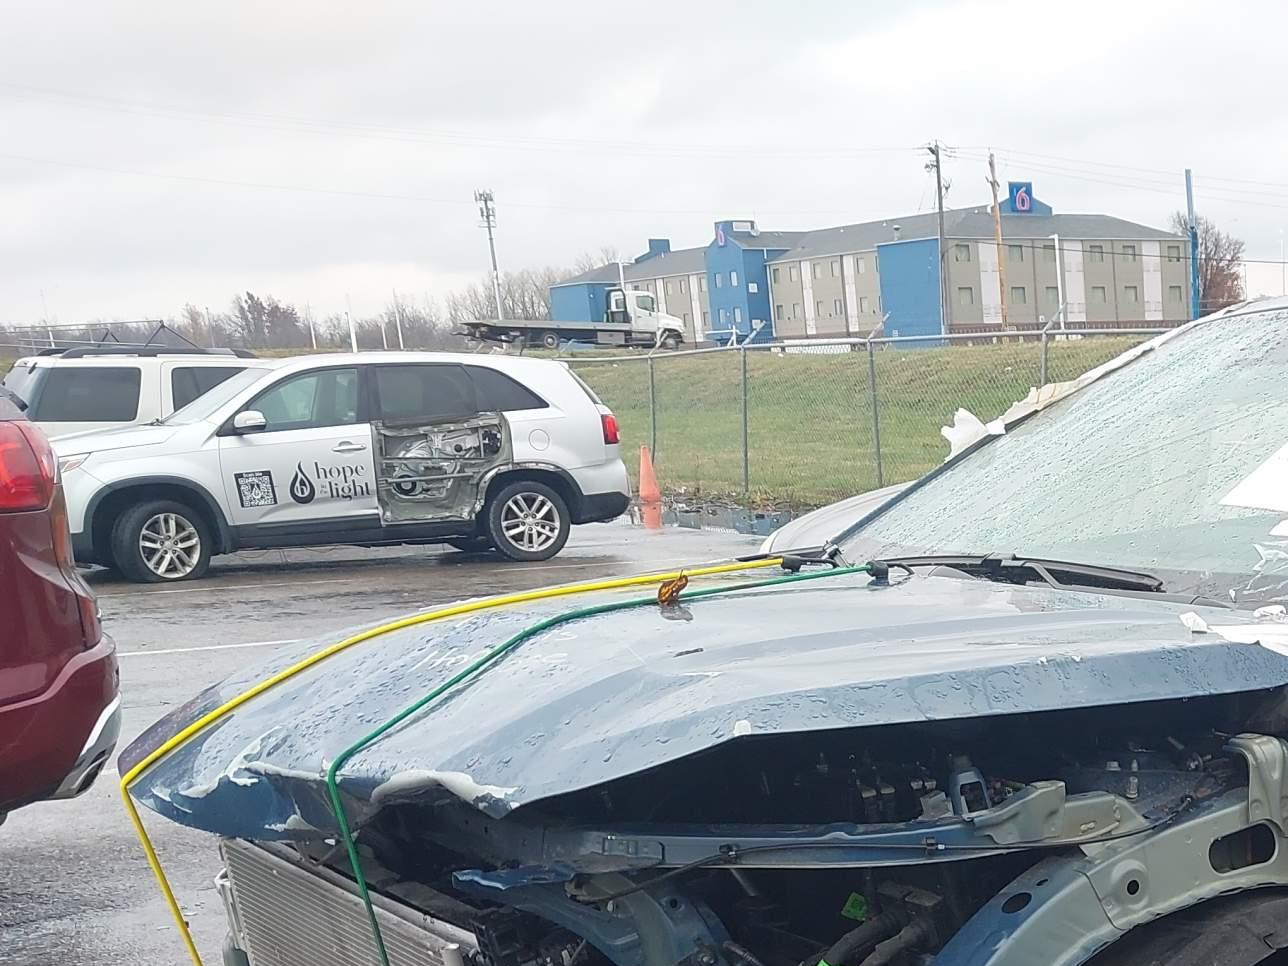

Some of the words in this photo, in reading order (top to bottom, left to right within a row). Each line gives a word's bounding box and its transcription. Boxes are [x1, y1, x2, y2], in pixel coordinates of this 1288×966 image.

[1015, 186, 1030, 211] 6
[314, 461, 366, 484] hope
[328, 478, 371, 501] light
